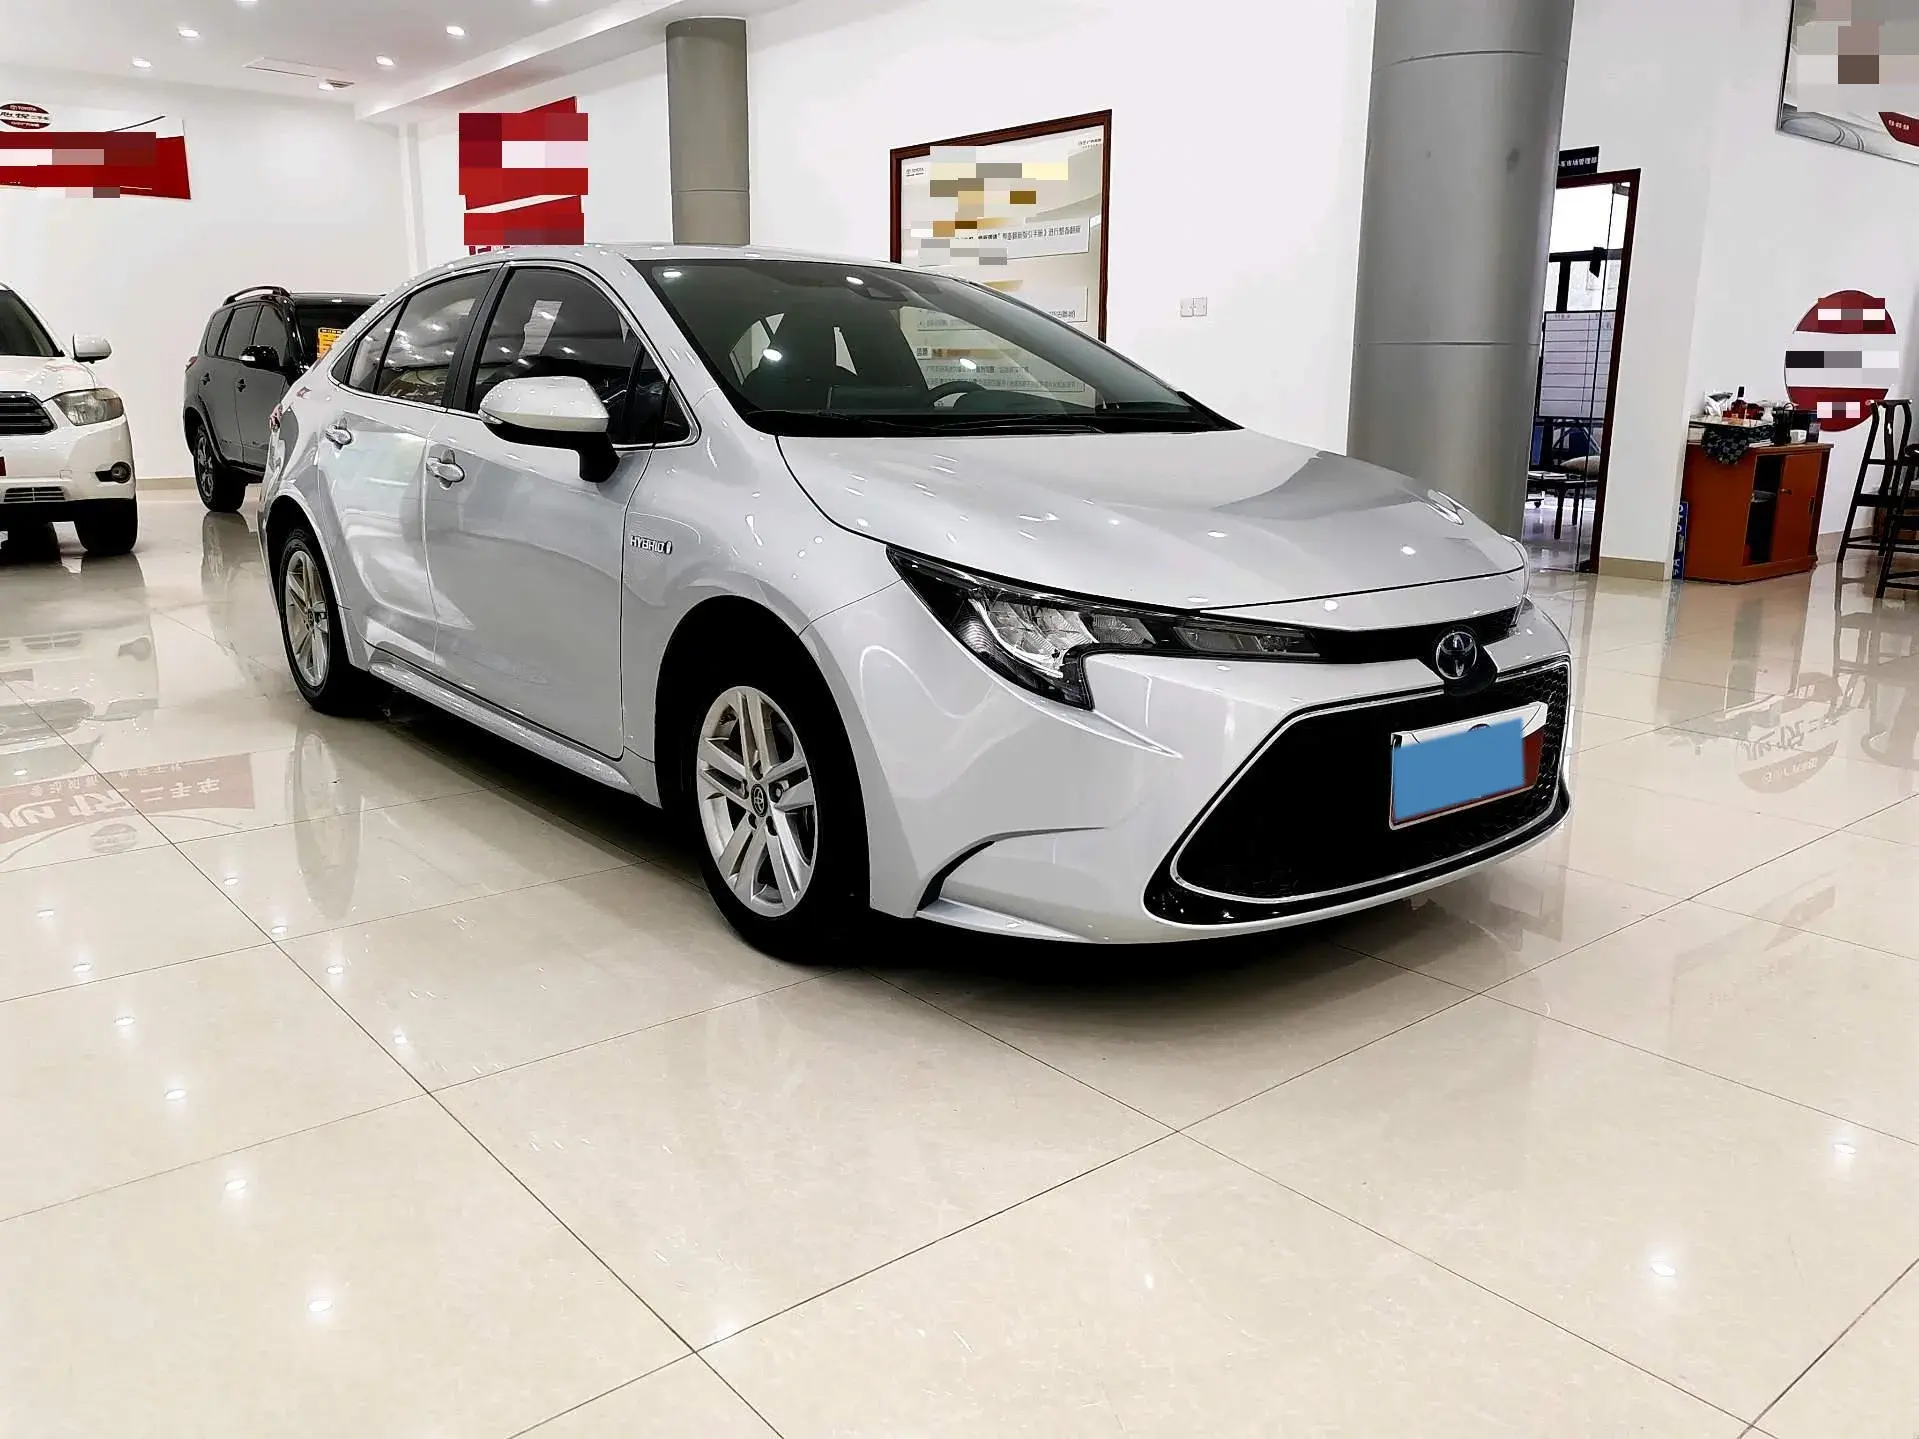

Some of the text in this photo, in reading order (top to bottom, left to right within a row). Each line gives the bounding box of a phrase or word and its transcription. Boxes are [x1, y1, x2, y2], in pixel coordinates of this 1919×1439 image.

[1559, 156, 1598, 167] 车市场管理部
[630, 535, 664, 553] HYBRID
